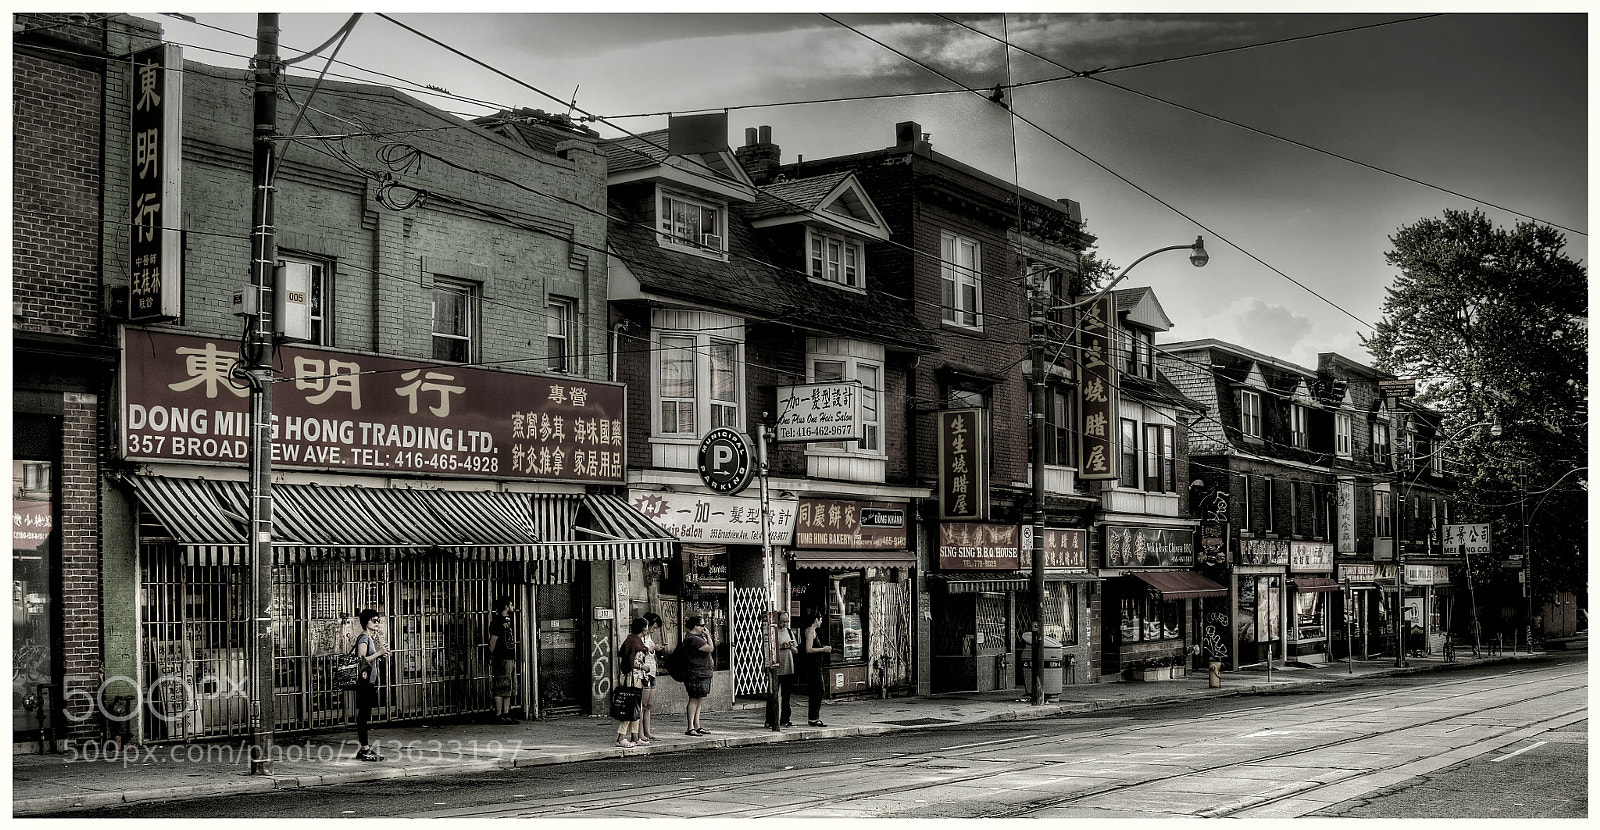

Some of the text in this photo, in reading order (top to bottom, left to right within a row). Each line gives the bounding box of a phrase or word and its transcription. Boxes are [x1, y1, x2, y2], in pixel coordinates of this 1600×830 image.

[134, 58, 161, 244] 東明行
[132, 266, 160, 295] 王桂林
[289, 292, 304, 302] 005
[168, 342, 466, 418] 東明行
[548, 384, 588, 407] 專營
[779, 386, 853, 410] 一加一髮型設計
[129, 404, 498, 454] DONG MIG HONG TRADING LTD.
[791, 413, 806, 425] Plus
[806, 413, 818, 424] One
[819, 412, 834, 423] Hair
[834, 410, 853, 422] Salon
[573, 416, 622, 446] 海味國藥
[781, 427, 796, 438] Tel:
[129, 434, 499, 473] 357 BROADEW AVE. TEL: 416-465-4928
[702, 431, 745, 456] MUNICIPAL
[511, 443, 622, 478] 針灸推拿 家居用品
[713, 445, 733, 470] P
[700, 465, 745, 491] PARKING
[640, 499, 662, 514] 1+1
[799, 502, 856, 529] 同慶餅家
[681, 524, 703, 538] Salon
[718, 529, 738, 539] Broadview
[797, 532, 813, 545] TUNG
[813, 533, 828, 545] HING
[829, 533, 851, 545] BAKERY
[1444, 526, 1488, 545] 美景公司
[940, 546, 957, 558] SING
[958, 546, 975, 558] SING
[995, 547, 1018, 558] HOUSE
